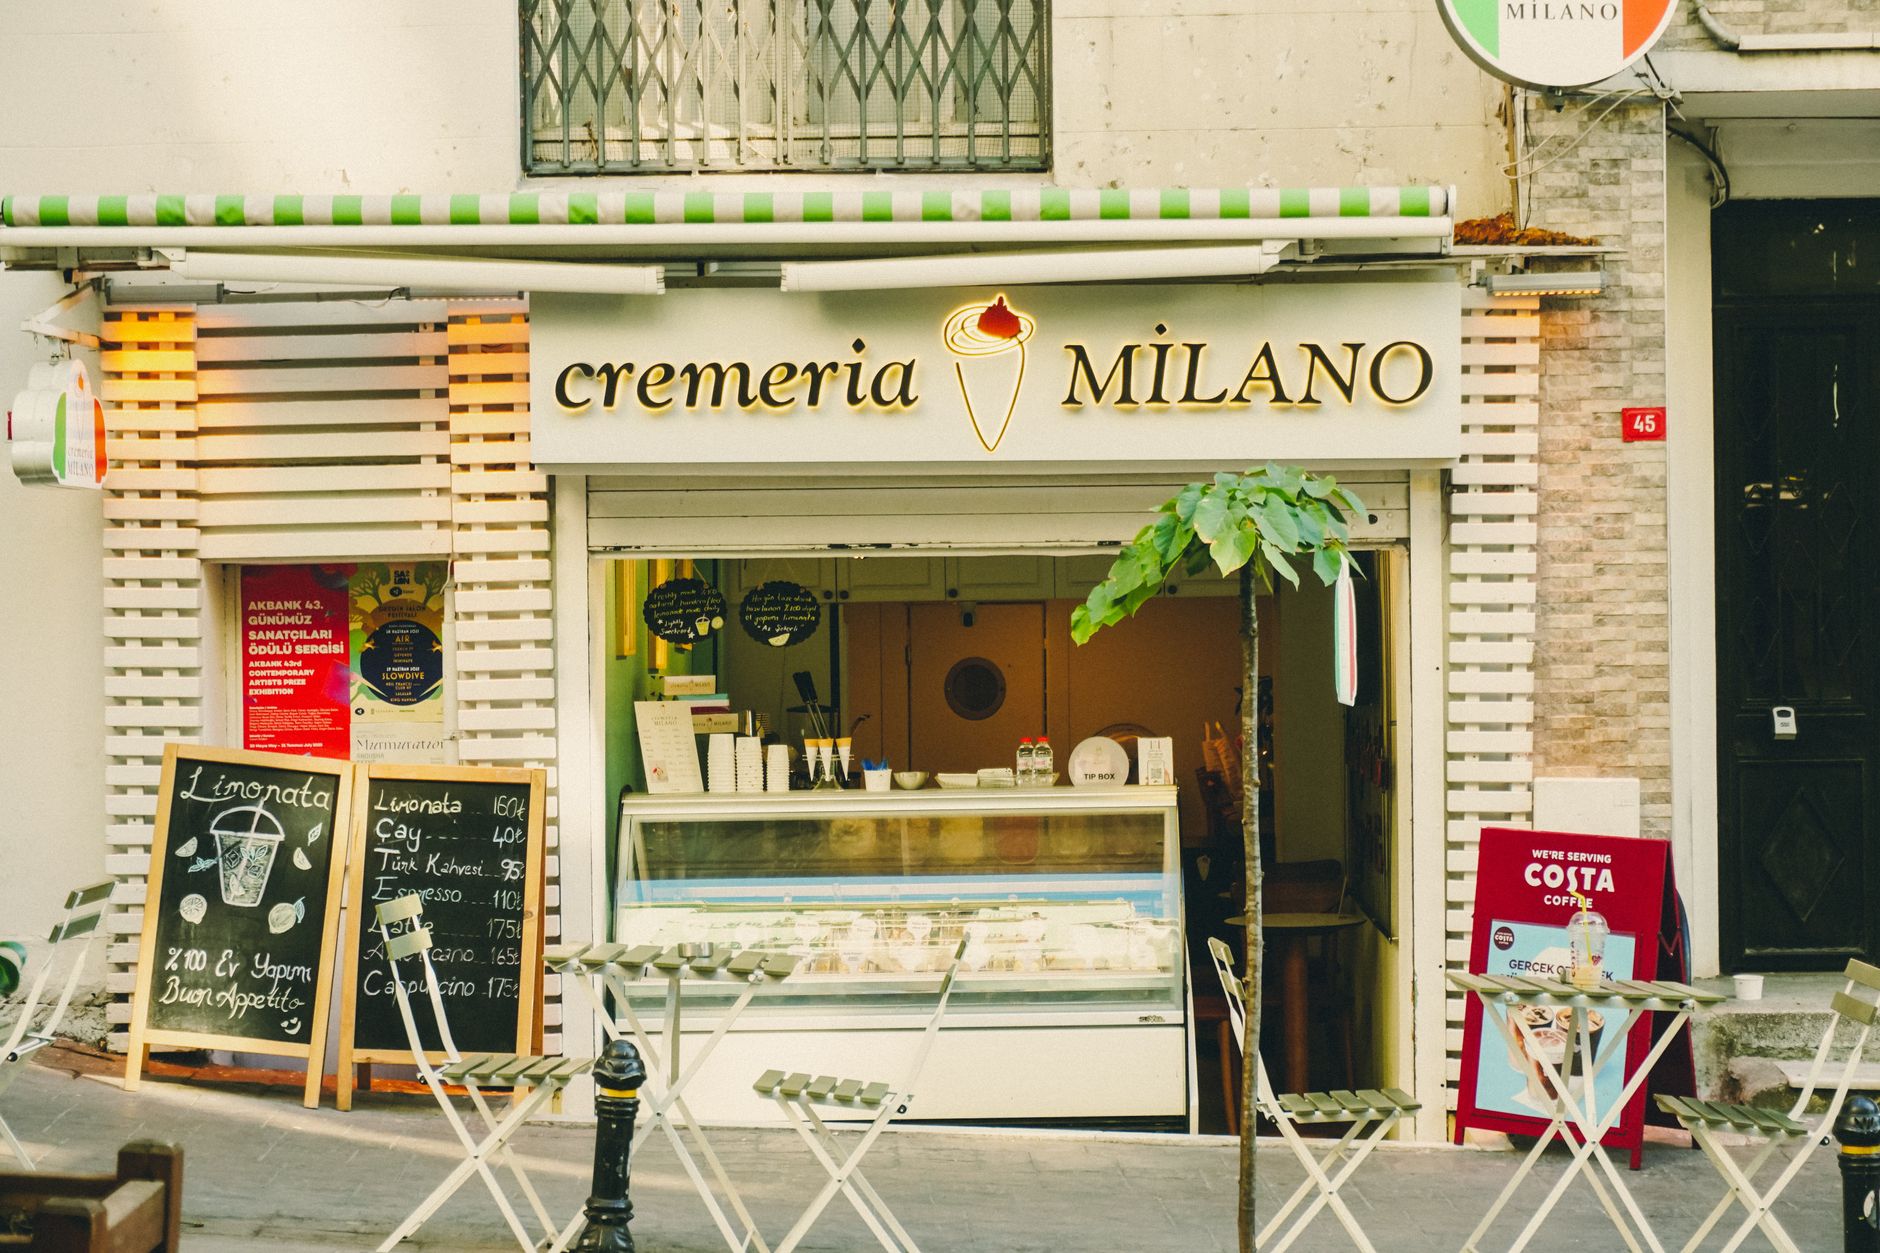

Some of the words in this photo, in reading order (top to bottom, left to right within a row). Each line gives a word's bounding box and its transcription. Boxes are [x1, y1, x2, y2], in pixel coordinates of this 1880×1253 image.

[1506, 1, 1618, 21] MİLANO
[554, 338, 920, 409] cremeria
[1061, 323, 1434, 405] MİLANO
[1634, 414, 1656, 433] 45
[248, 601, 302, 610] AKBANK
[304, 600, 324, 610] 43.
[248, 612, 312, 625] GÜNÜMÜZ
[248, 630, 332, 642] SANATÇILARI
[248, 642, 293, 655] ÖDÜLÜ
[294, 641, 344, 655] SERGİSİ
[382, 672, 425, 680] SLOWDIVE
[180, 766, 330, 811] Limonata
[374, 789, 462, 814] Limonata
[376, 817, 422, 852] Çay
[374, 848, 418, 875] Türk
[425, 852, 484, 876] Kahvesi
[1532, 849, 1565, 860] WE'RE
[1567, 852, 1612, 864] SERVING
[1524, 862, 1615, 893] COSTA
[368, 912, 434, 935] Late
[1494, 934, 1514, 942] COSTA
[364, 941, 475, 963] Acano
[215, 949, 241, 978] Ev
[1509, 959, 1555, 975] GERÇEK
[159, 975, 214, 1006] Buon
